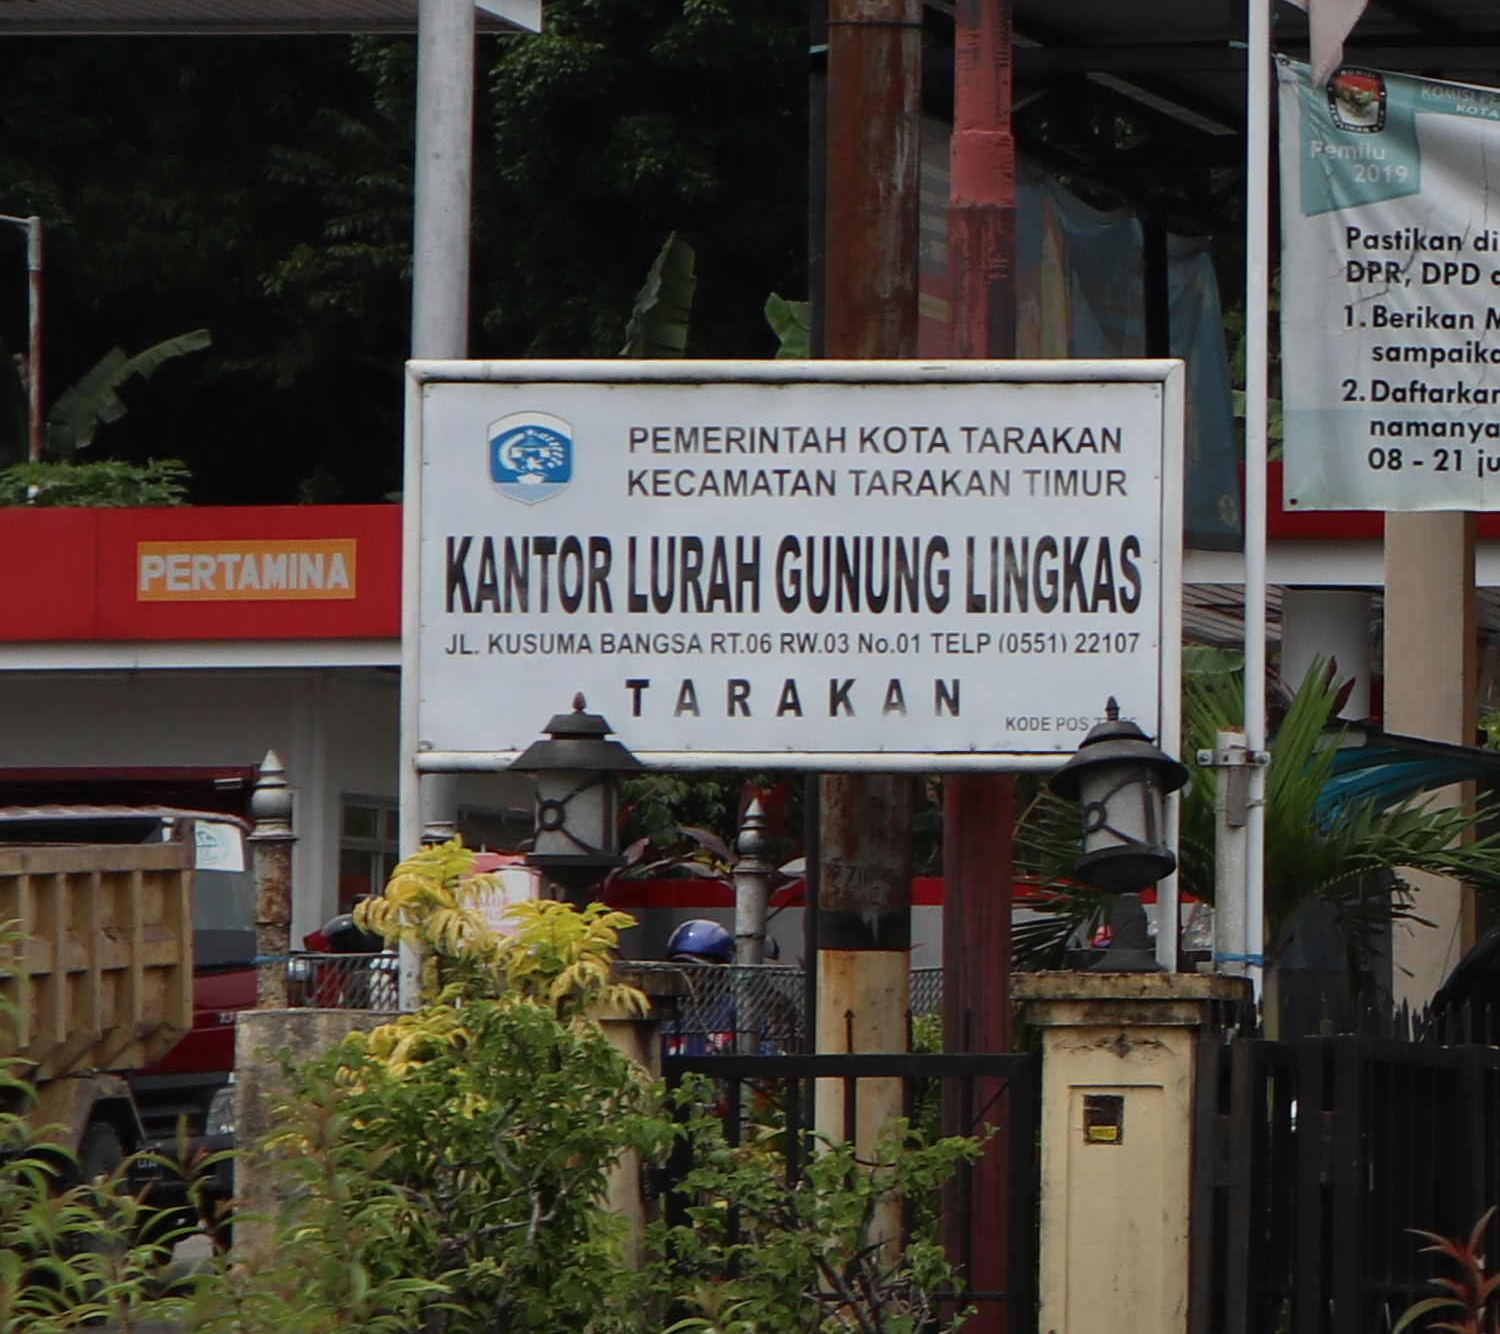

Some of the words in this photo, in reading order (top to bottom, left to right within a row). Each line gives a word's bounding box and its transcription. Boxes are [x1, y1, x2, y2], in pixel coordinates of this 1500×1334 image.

[1311, 141, 1386, 160] Pemilu
[1354, 165, 1408, 182] 2019
[1346, 227, 1463, 253] Pastikan
[1346, 260, 1412, 288] DPR,
[1421, 261, 1480, 286] DPD
[1372, 305, 1475, 332] Berikan
[628, 426, 848, 455] PEMERINTAH
[859, 426, 950, 455] KOTA
[960, 426, 1123, 455] TARAKAN
[626, 468, 837, 498] KECAMATAN
[852, 468, 1012, 498] TARAKAN
[1026, 468, 1129, 498] TIMUR
[139, 552, 349, 592] PERTAMINA
[445, 535, 613, 614] KANTOR
[626, 535, 761, 614] LURAH
[775, 534, 950, 614] GUNUNG
[965, 535, 1142, 614] LINGKAS
[444, 632, 480, 656] JL.
[487, 632, 593, 655] KUSUMA
[600, 632, 702, 655] BANGSA
[709, 632, 772, 655] RT.06
[779, 632, 851, 655] RW.03
[857, 632, 921, 655] No.01
[929, 632, 992, 655] TELP
[997, 631, 1068, 658] (0551)
[1074, 632, 1140, 655] 22107
[625, 678, 962, 718] TARAKAN
[1005, 717, 1050, 731] KODE
[1056, 717, 1088, 731] POS
